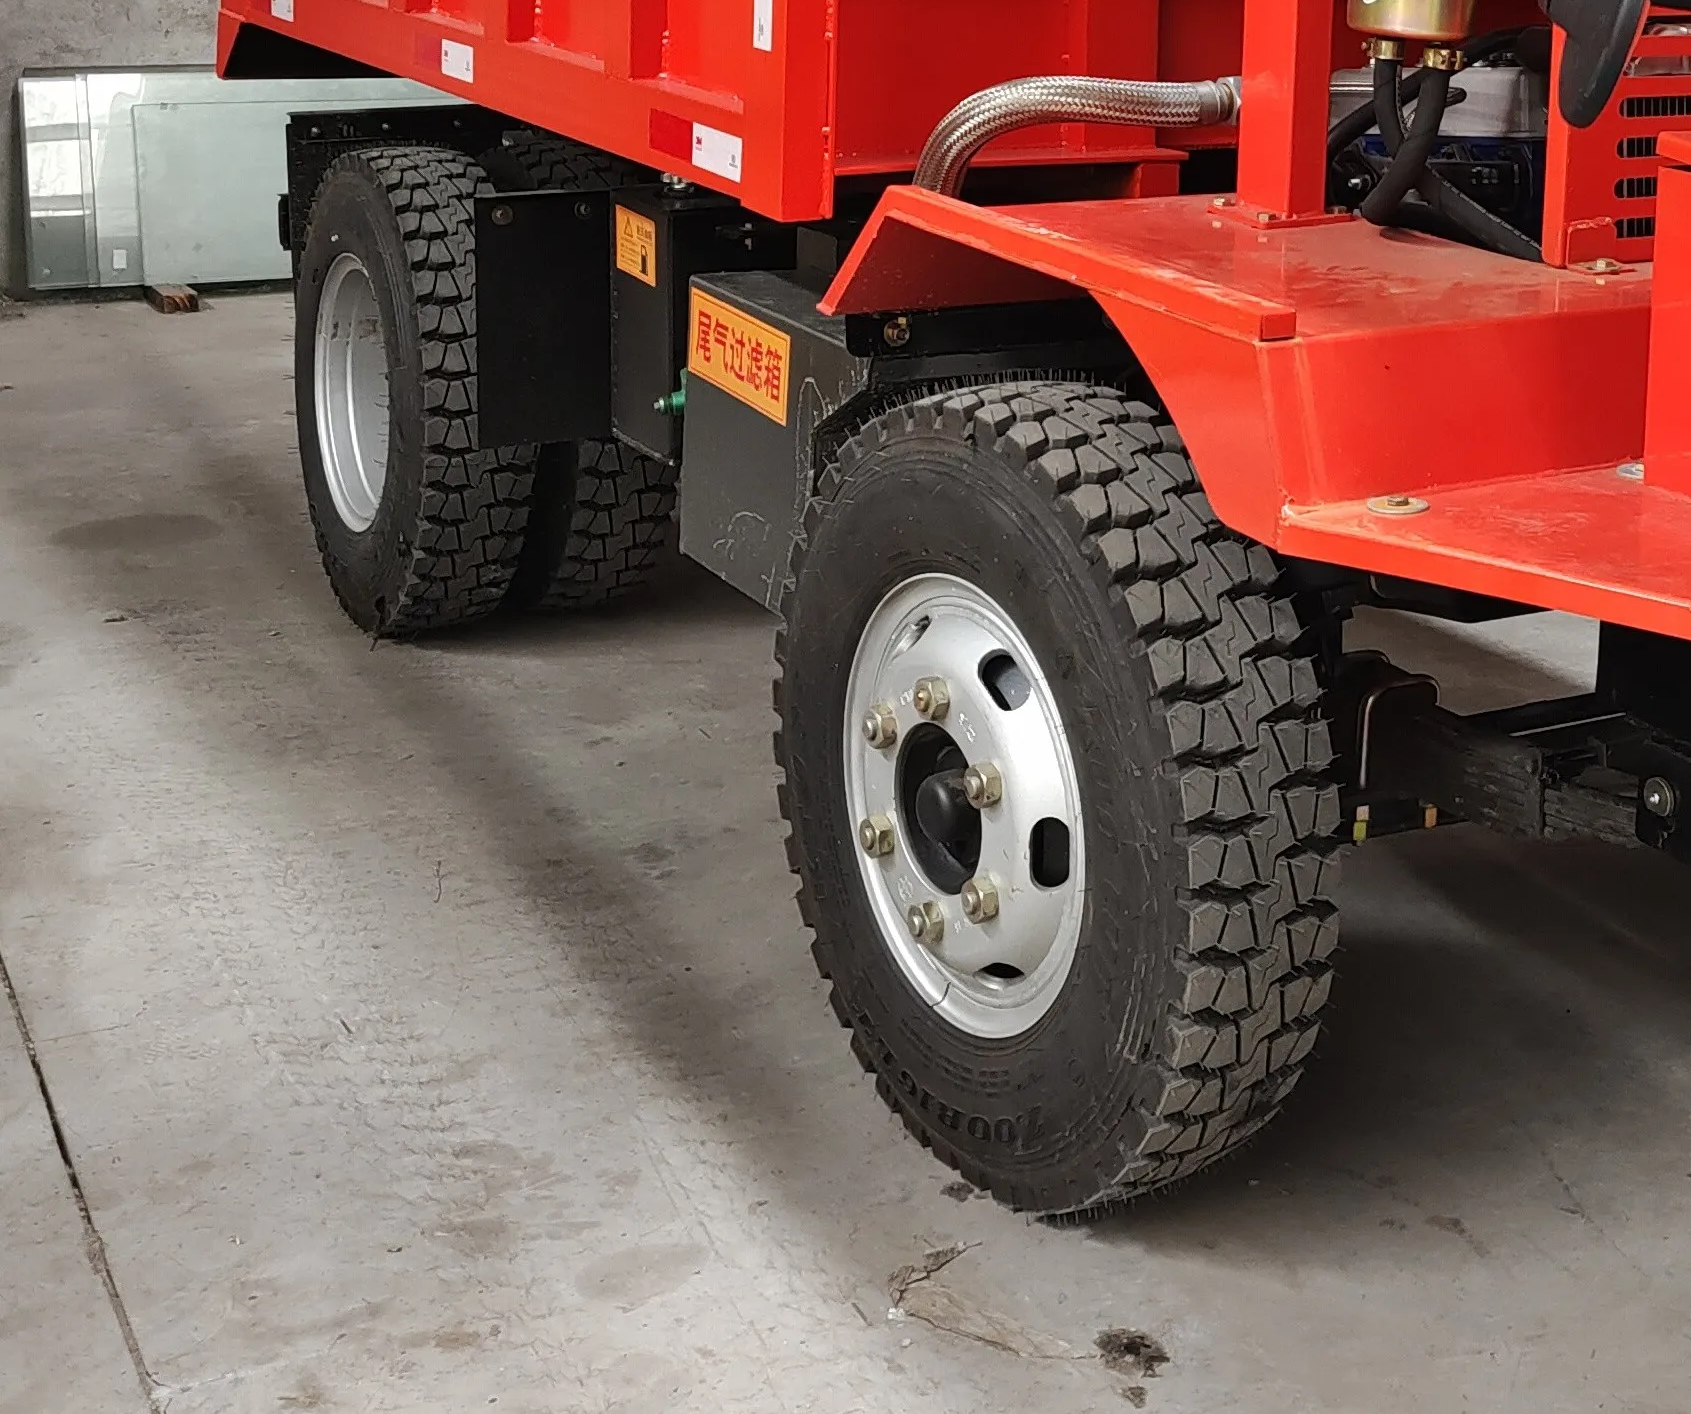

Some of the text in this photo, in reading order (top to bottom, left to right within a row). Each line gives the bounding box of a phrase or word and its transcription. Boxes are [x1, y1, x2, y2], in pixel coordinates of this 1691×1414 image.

[695, 310, 783, 404] 尾气过滤箱
